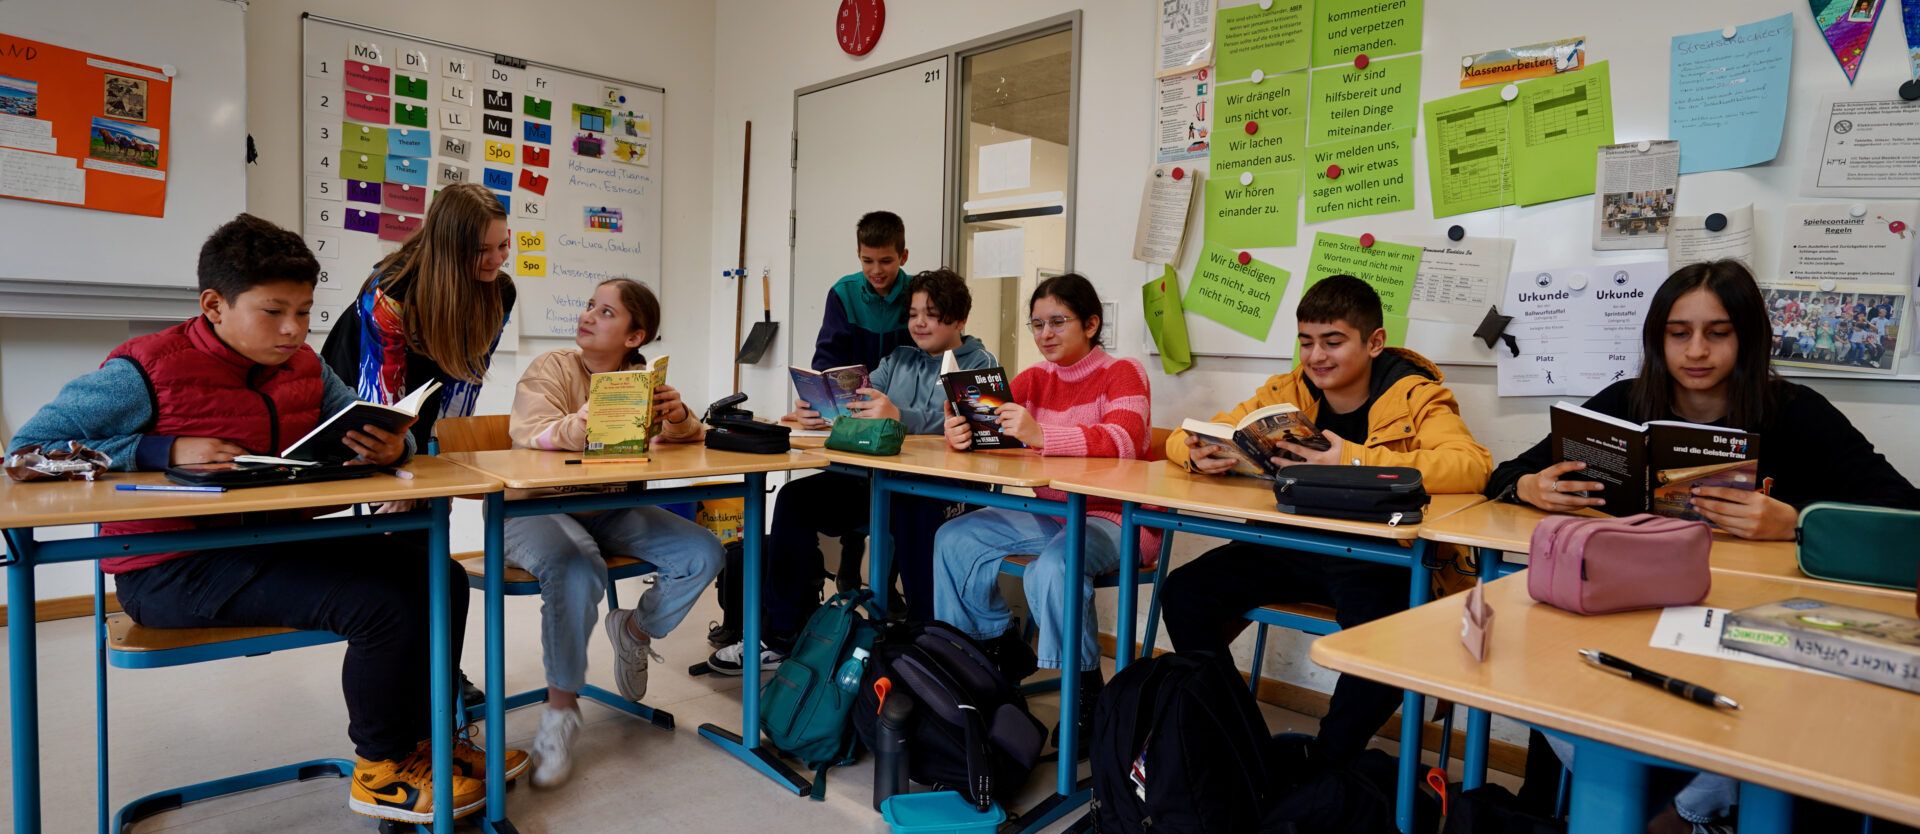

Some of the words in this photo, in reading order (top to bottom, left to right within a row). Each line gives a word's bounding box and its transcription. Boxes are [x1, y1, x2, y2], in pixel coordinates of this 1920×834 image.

[1328, 0, 1406, 22] kommentieren
[1328, 27, 1347, 40] und
[1351, 19, 1404, 34] verpetzen
[354, 45, 377, 59] Mo
[1334, 38, 1396, 56] niemanden.
[406, 54, 419, 66] Di
[321, 62, 328, 73] 1
[1464, 57, 1553, 77] Klassenarbeiten
[492, 69, 508, 81] Do
[925, 69, 939, 83] 211
[1343, 73, 1361, 83] Wir
[1364, 68, 1386, 80] sind
[536, 78, 547, 88] Fr
[452, 86, 463, 99] LL
[1227, 95, 1243, 105] Wir
[1246, 87, 1290, 102] drängeln
[1326, 88, 1377, 103] hilfsbereit
[1381, 83, 1402, 96] und
[321, 96, 328, 107] 2
[488, 94, 507, 106] Mu
[1225, 115, 1241, 124] uns
[1245, 109, 1269, 120] nicht
[1272, 107, 1291, 116] vor.
[1331, 108, 1360, 119] teilen
[1363, 104, 1393, 115] Dinge
[449, 114, 461, 124] LL
[488, 120, 507, 132] Mu
[1328, 122, 1394, 137] miteinander.
[321, 128, 328, 139] 3
[528, 128, 546, 138] Ma
[446, 141, 464, 155] Rel
[1229, 140, 1246, 151] Wir
[1250, 136, 1282, 149] lachen
[489, 146, 510, 158] Spo
[1315, 152, 1333, 162] Wir
[1336, 145, 1374, 159] melden
[1378, 141, 1399, 151] uns,
[321, 157, 329, 167] 4
[1216, 156, 1272, 170] niemanden
[1275, 153, 1295, 163] aus.
[396, 166, 417, 174] Theater
[1317, 168, 1344, 179] wn
[1348, 164, 1364, 175] wir
[1367, 158, 1398, 171] etwas
[444, 169, 462, 181] Rel
[489, 173, 507, 186] Ma
[321, 183, 328, 193] 5
[1313, 186, 1342, 198] sagen
[1346, 180, 1379, 192] wollen
[1383, 173, 1404, 186] und
[1225, 190, 1242, 200] Wir
[1246, 187, 1274, 198] hören
[525, 203, 538, 214] KS
[1316, 202, 1344, 213] rufen
[1348, 198, 1373, 209] nicht
[1376, 194, 1400, 205] rein.
[321, 211, 328, 221] 6
[1219, 205, 1262, 217] einander
[1265, 205, 1278, 214] zu.
[318, 241, 325, 251] 7
[521, 236, 541, 247] Spo
[1318, 239, 1338, 249] Einen
[1340, 243, 1360, 253] Streit
[1361, 247, 1386, 256] tragen
[1387, 251, 1400, 259] wir
[1402, 254, 1415, 262] mit
[523, 261, 540, 270] Spo
[1210, 252, 1227, 266] Wir
[1228, 259, 1276, 285] beleidigen
[1323, 253, 1351, 263] Worten
[1353, 258, 1368, 267] und
[1369, 261, 1388, 271] nicht
[1390, 264, 1403, 272] mit
[320, 272, 328, 282] 8
[1317, 264, 1342, 275] Gewalt
[1361, 272, 1374, 281] Wir
[1376, 274, 1404, 286] bleiben
[1203, 270, 1219, 281] uns
[1221, 277, 1245, 294] nicht,
[1248, 288, 1271, 302] auch
[1518, 290, 1570, 302] Urkunde
[1596, 288, 1644, 300] Urkunde
[1199, 287, 1222, 302] nicht
[1223, 294, 1235, 307] im
[1237, 300, 1261, 319] Spaß.
[321, 311, 329, 322] 9
[1525, 308, 1566, 317] Ballwurfstaffel
[975, 375, 987, 384] Die
[987, 372, 1002, 383] drei
[1713, 435, 1727, 443] Die
[1730, 437, 1747, 445] drei
[1703, 449, 1746, 459] Geisterfrau
[1731, 444, 1748, 452] ???
[702, 511, 743, 522] Plastikmü
[1795, 638, 1850, 666] ÖFFNEN
[1850, 656, 1896, 674] NICHT
